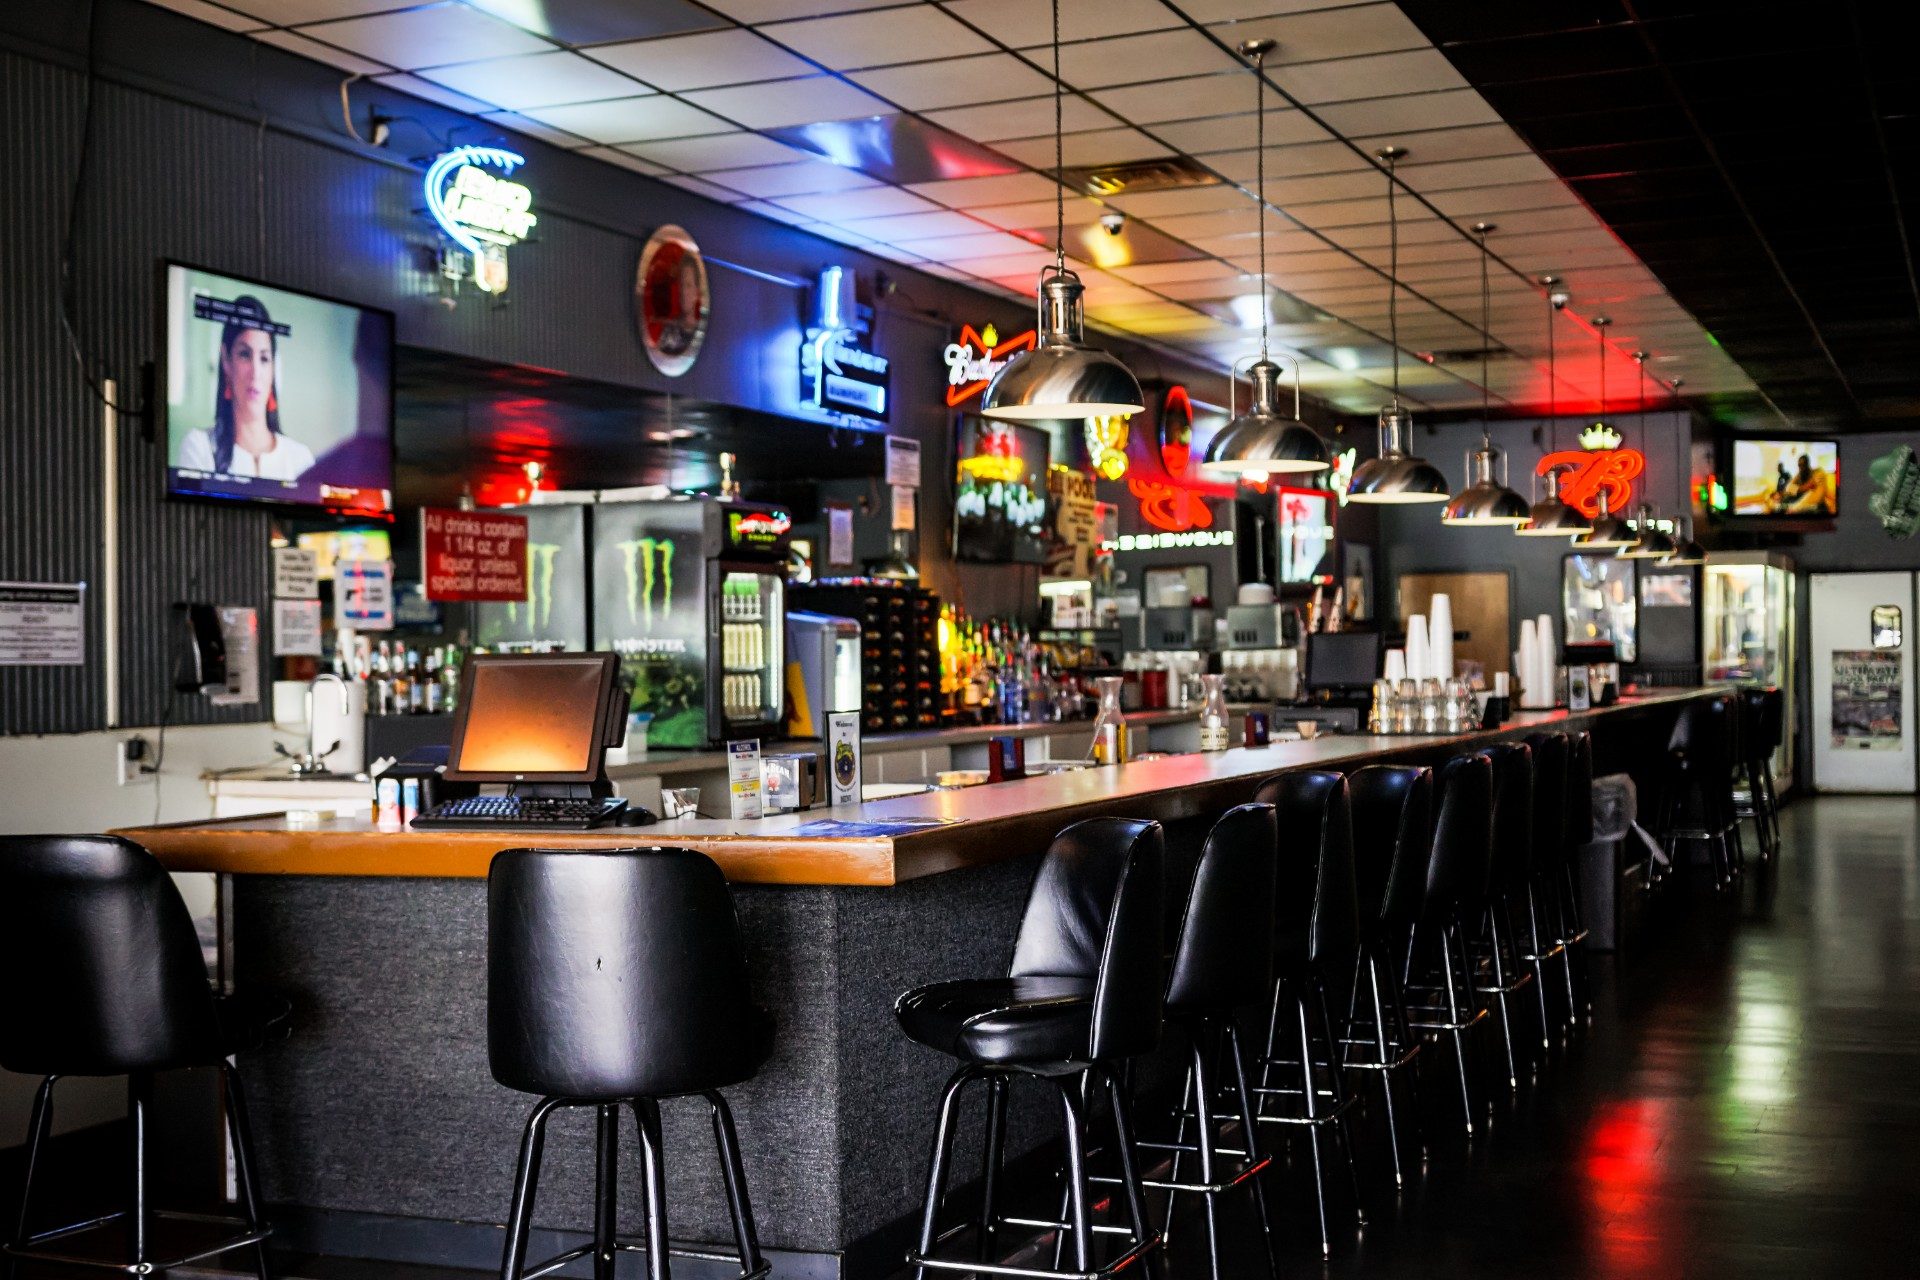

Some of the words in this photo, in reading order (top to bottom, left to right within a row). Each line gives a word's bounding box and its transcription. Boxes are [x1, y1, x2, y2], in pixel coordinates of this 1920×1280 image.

[425, 515, 442, 532] All
[445, 517, 480, 536] drinks
[484, 522, 526, 539] contain
[444, 535, 452, 552] 1
[456, 536, 475, 552] 1/4
[497, 537, 510, 556] of
[479, 557, 517, 574] unless
[431, 573, 475, 594] special
